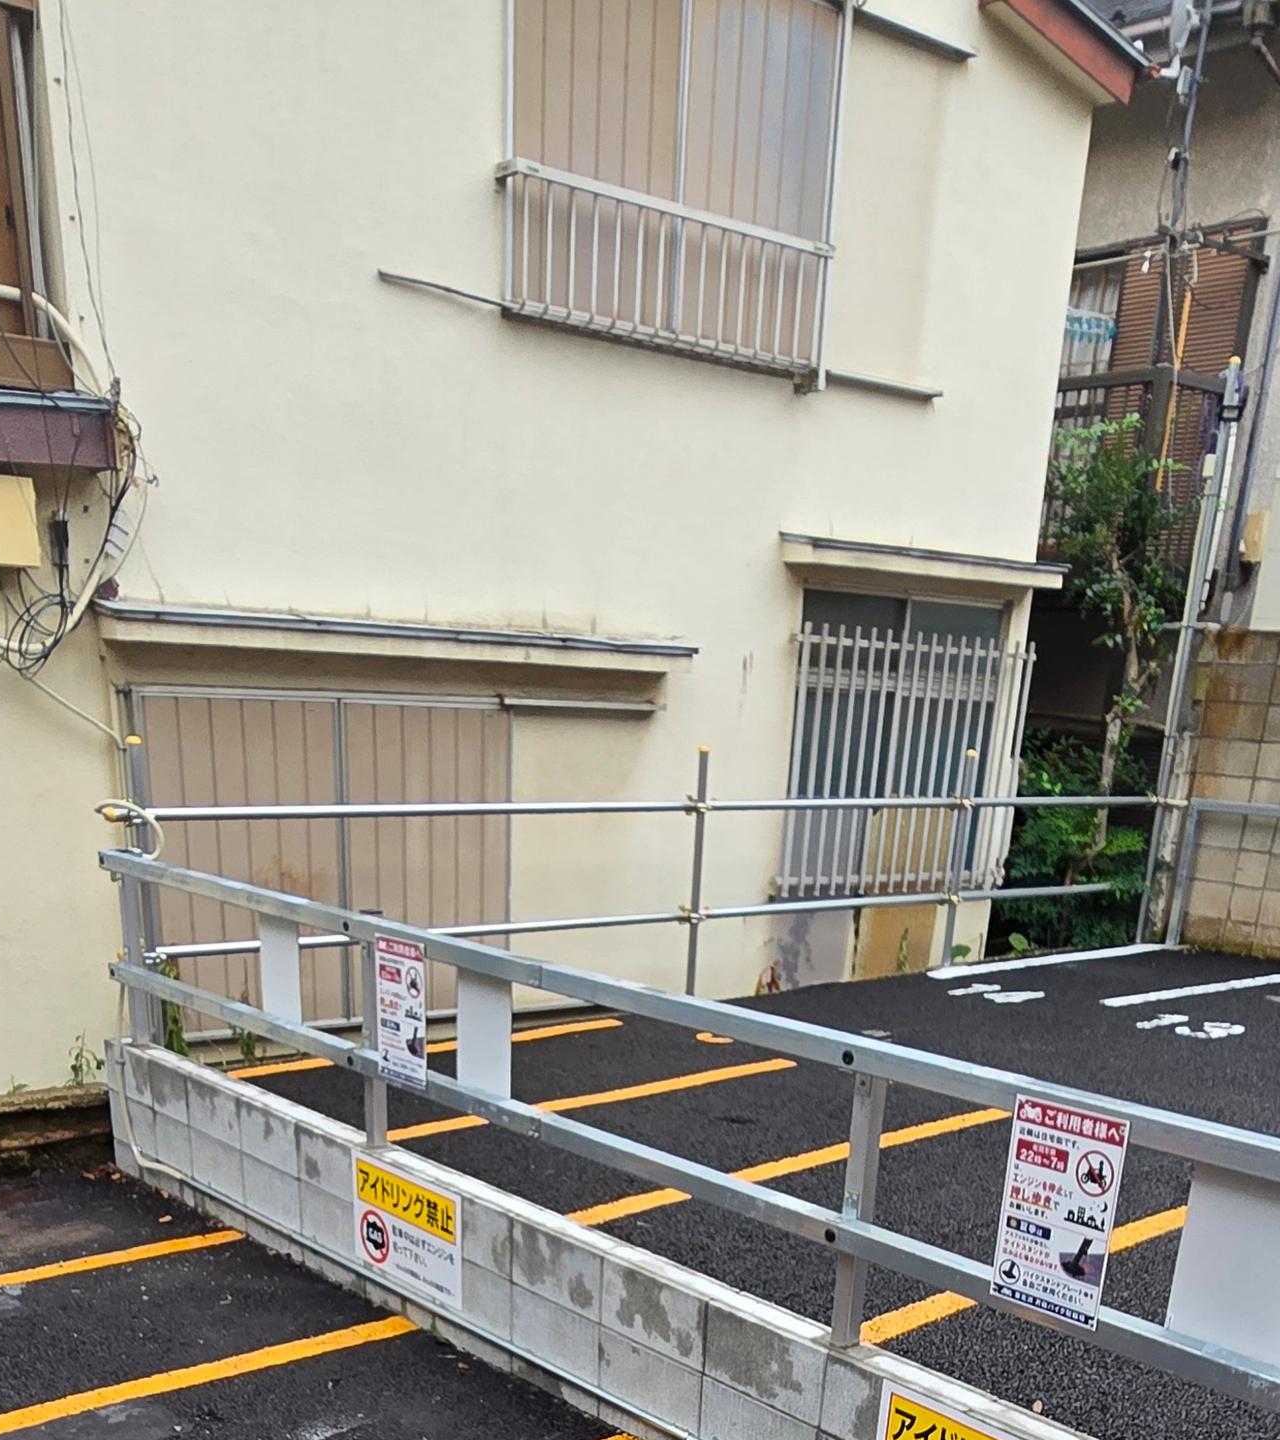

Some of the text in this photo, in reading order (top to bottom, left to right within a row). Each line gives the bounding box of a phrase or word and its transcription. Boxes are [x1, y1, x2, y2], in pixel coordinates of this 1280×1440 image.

[1044, 1109, 1121, 1142] ご利用者様へ
[358, 1168, 454, 1236] アイドリング禁止
